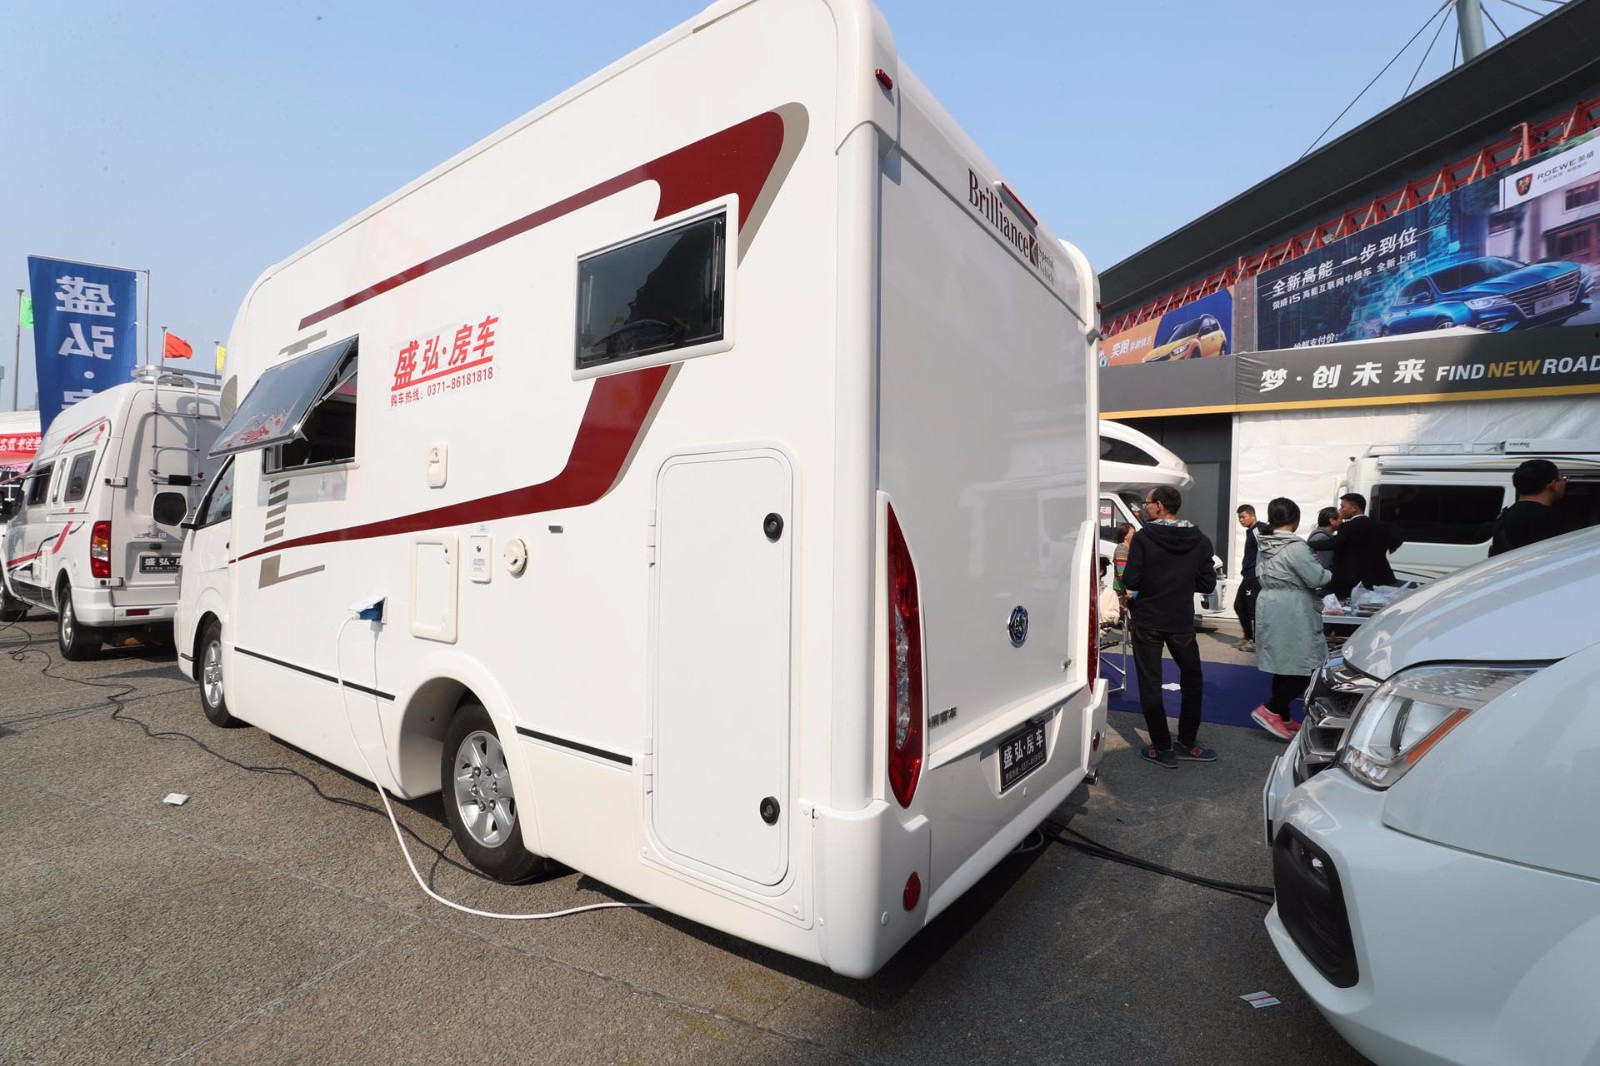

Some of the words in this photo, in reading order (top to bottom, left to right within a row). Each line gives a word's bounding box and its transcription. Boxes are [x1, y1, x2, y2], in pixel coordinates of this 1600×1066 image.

[1537, 159, 1577, 180] ROEWE
[967, 168, 1029, 258] Brilliance
[1273, 259, 1333, 297] 全新高能
[1341, 227, 1418, 265] 一步到位
[1376, 250, 1417, 273] 全新上市
[391, 315, 499, 391] 盛弘·房车
[1436, 364, 1485, 382] FIND
[1487, 359, 1541, 379] NEW
